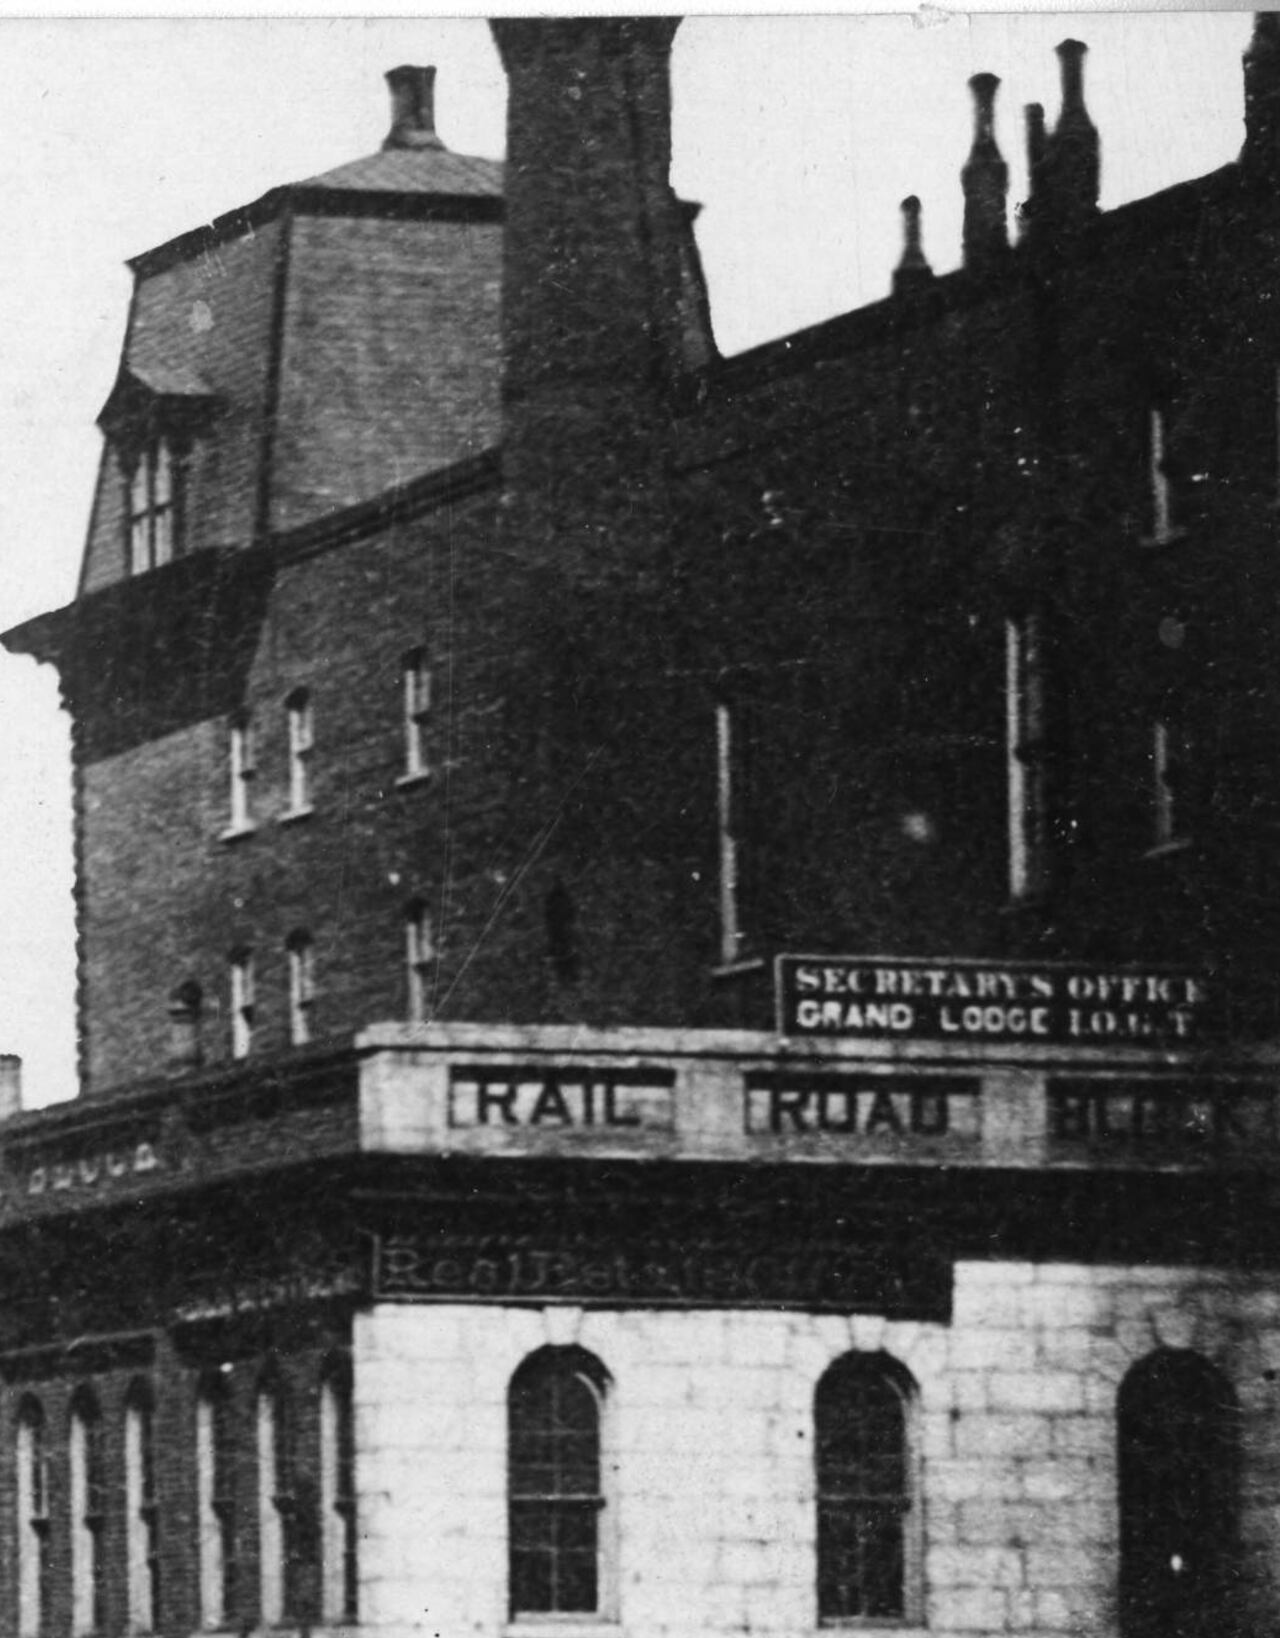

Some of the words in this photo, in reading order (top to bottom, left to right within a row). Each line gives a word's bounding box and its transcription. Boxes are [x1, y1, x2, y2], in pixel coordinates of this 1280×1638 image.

[797, 1000, 913, 1030] GRAND
[940, 1005, 1048, 1034] LODGE
[477, 1076, 642, 1125] RAIL
[770, 1083, 950, 1137] ROAD
